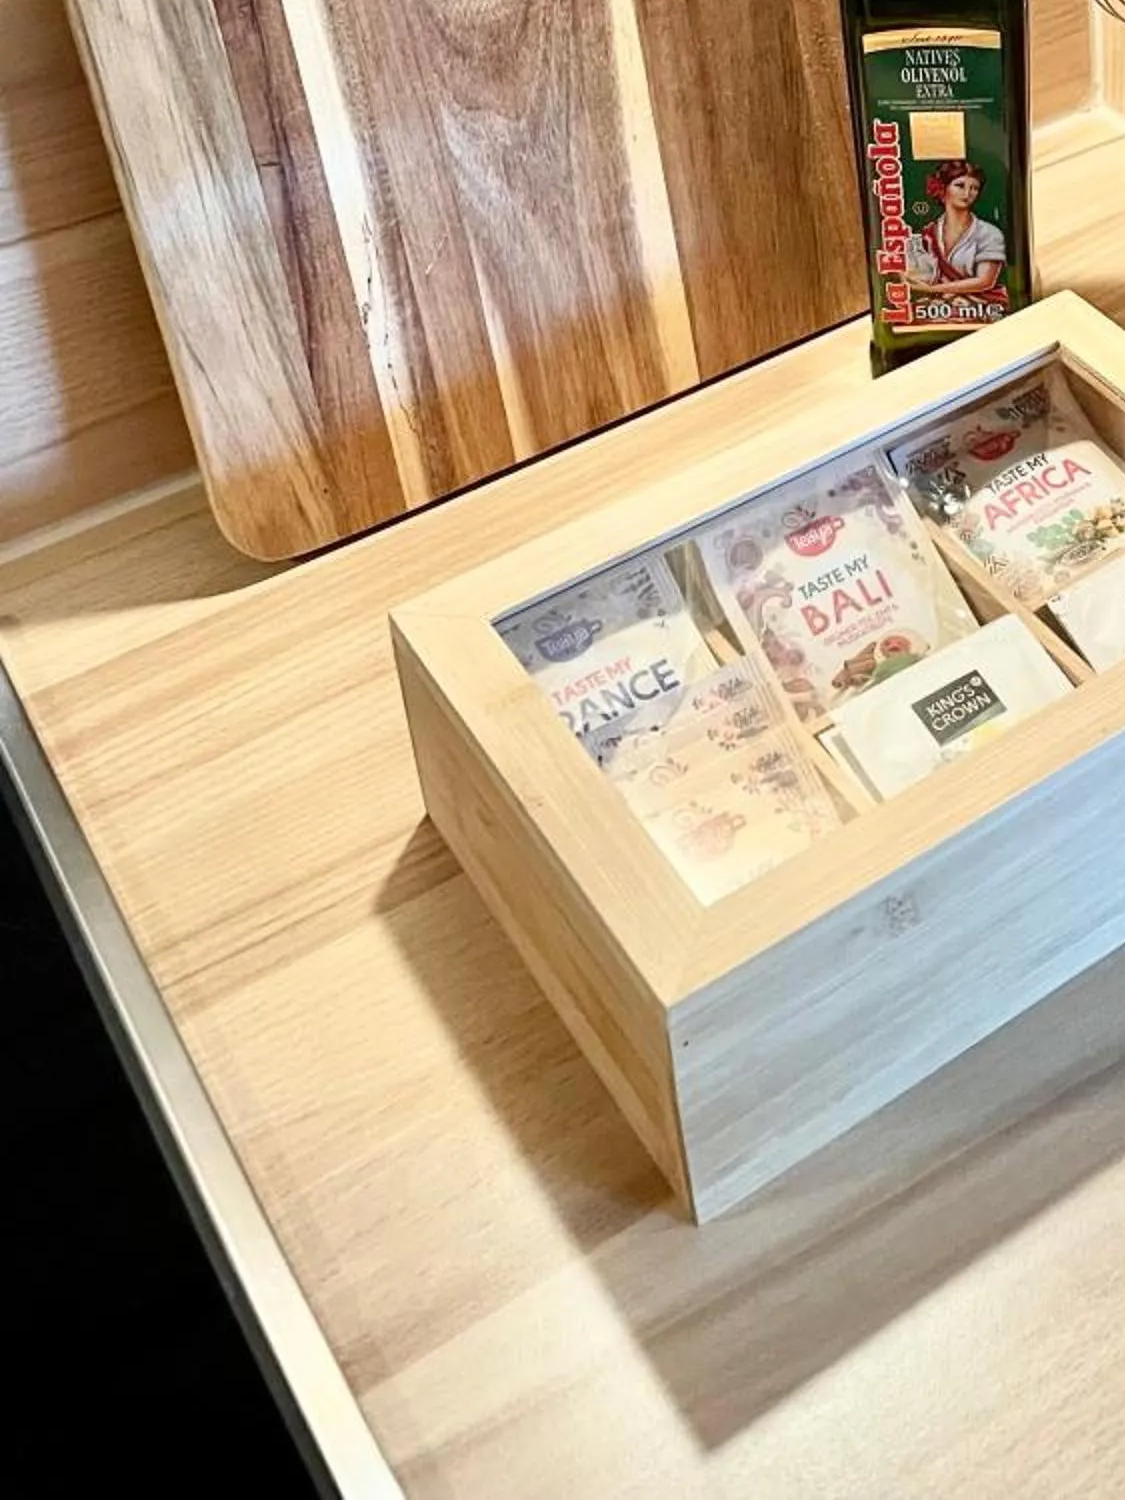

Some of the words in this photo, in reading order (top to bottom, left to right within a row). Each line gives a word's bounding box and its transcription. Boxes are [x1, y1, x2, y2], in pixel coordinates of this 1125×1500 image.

[901, 62, 968, 83] OLIVENÖL
[905, 49, 961, 65] NATIVES
[915, 84, 954, 99] EXTRA
[867, 119, 910, 276] Española
[880, 281, 913, 325] La
[915, 303, 951, 319] 500
[984, 458, 1092, 531] AFRICA
[987, 467, 1027, 495] TASTE
[1027, 453, 1049, 475] MY
[798, 567, 845, 600] TASTE
[844, 554, 869, 577] MY
[800, 569, 893, 637] BALI
[552, 668, 607, 705] TASTE
[606, 656, 633, 678] MY
[931, 692, 991, 731] CROWN
